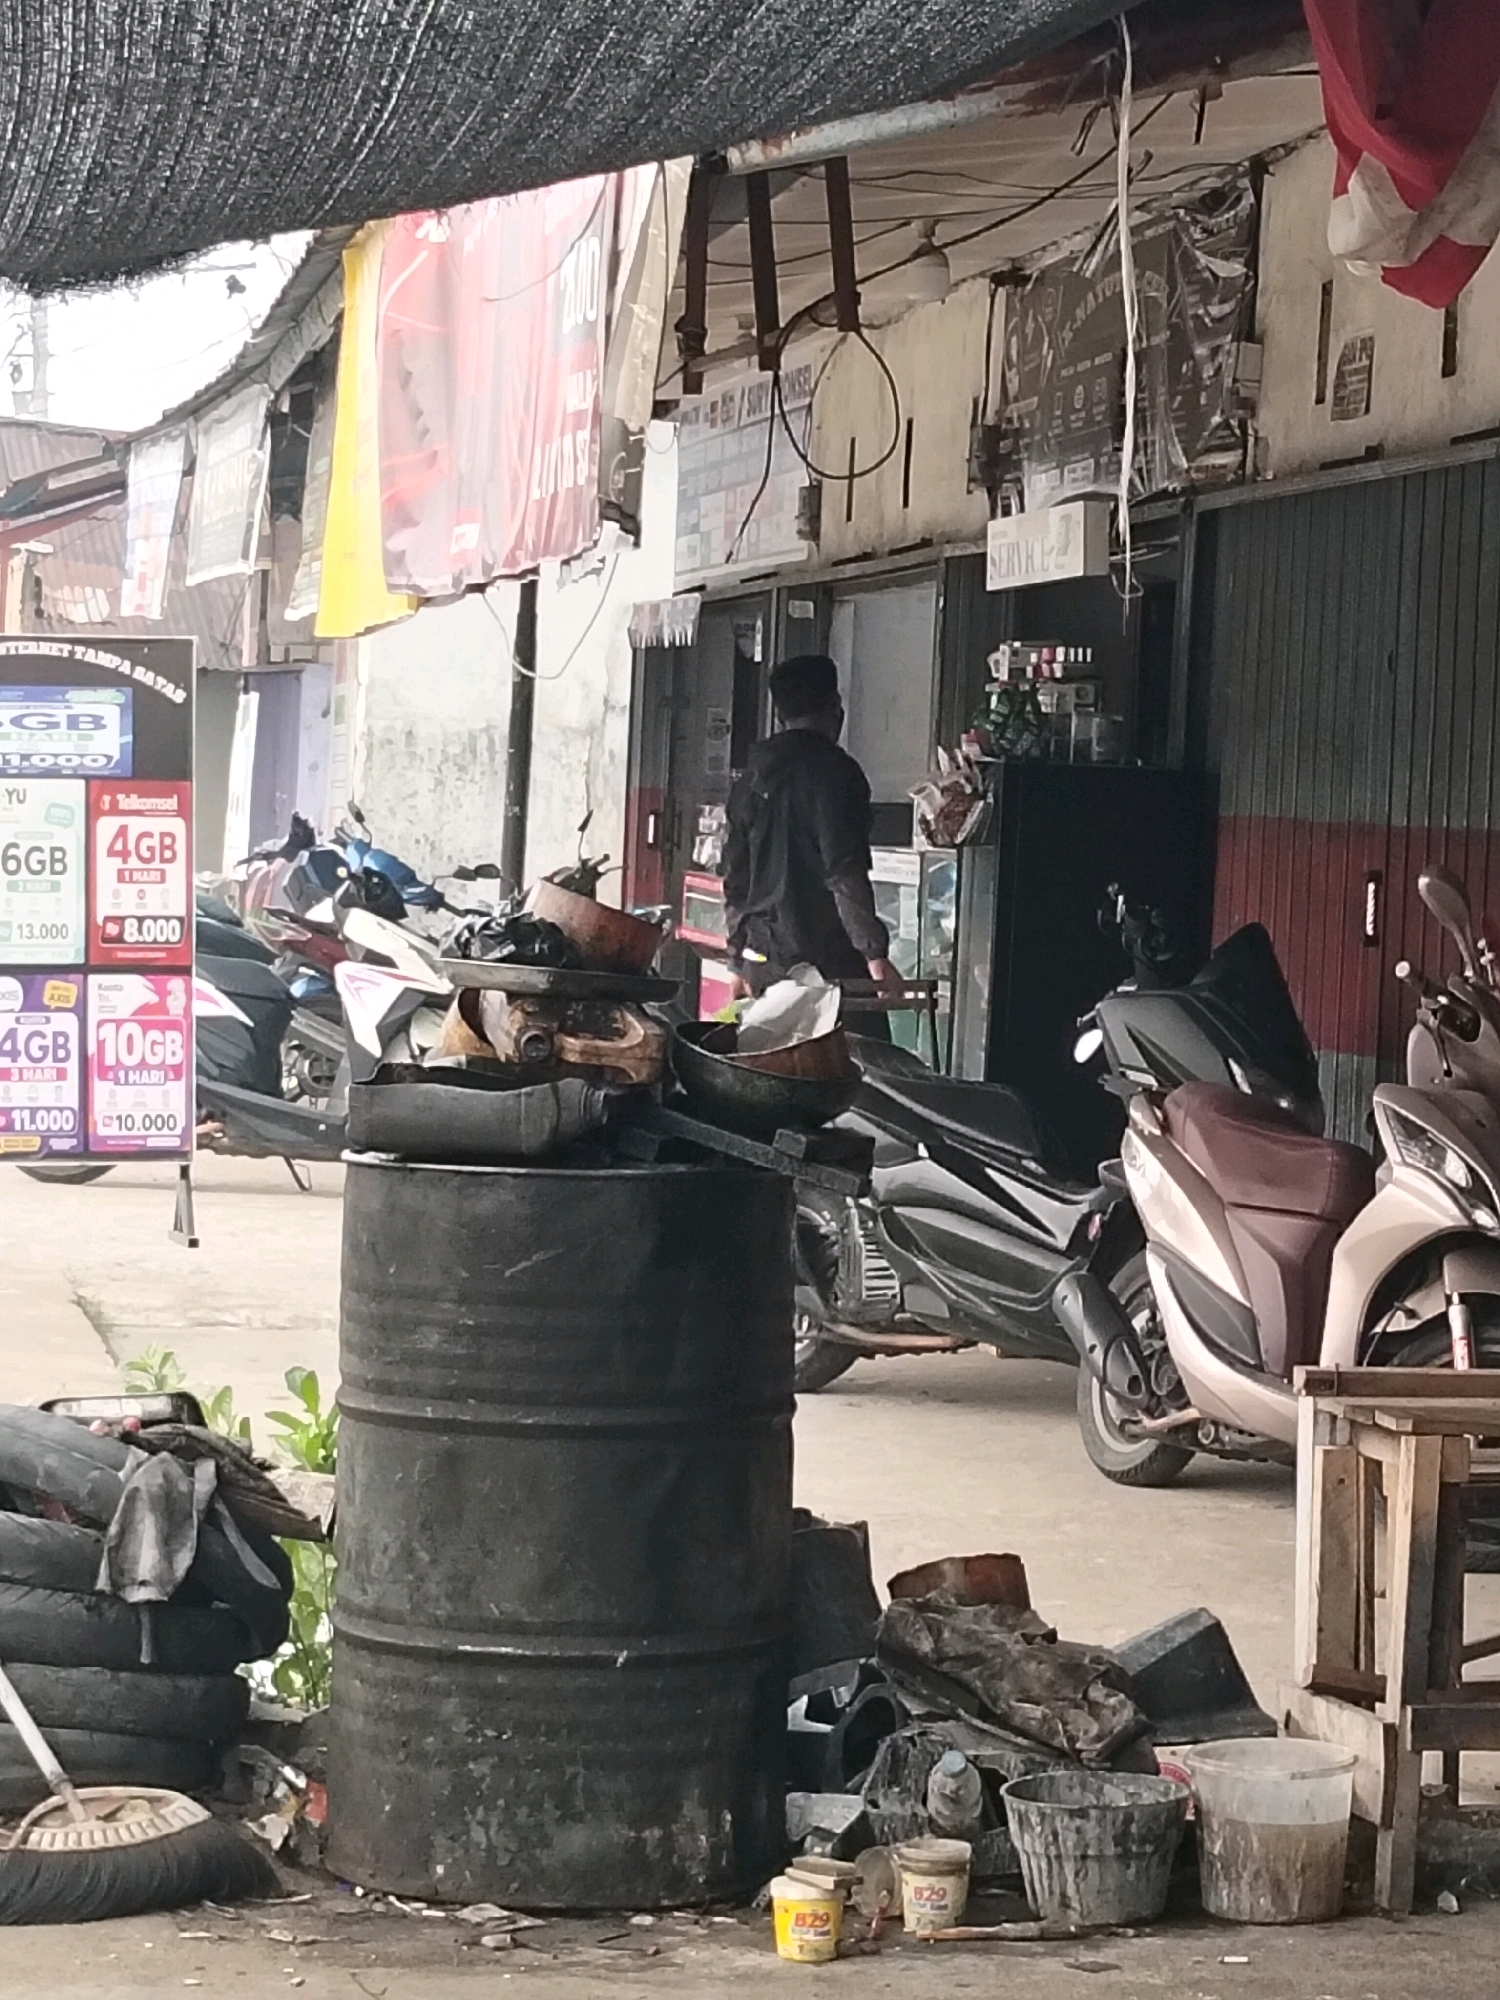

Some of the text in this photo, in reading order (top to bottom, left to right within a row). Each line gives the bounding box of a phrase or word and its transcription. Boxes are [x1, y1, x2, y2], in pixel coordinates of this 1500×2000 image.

[0, 712, 107, 731] GB
[0, 753, 108, 768] 1.000
[106, 824, 178, 865] 4GB
[1, 842, 68, 876] 6GB
[16, 922, 69, 940] 13.000
[123, 917, 181, 943] 8.000
[0, 1027, 72, 1064] 4GB
[98, 1021, 184, 1067] 10GB
[11, 1067, 57, 1081] 3 HARI
[118, 1069, 165, 1085] 1 HARI
[11, 1109, 75, 1131] 11.000
[115, 1113, 178, 1132] 10.000
[914, 1886, 947, 1902] B29
[794, 1911, 831, 1929] B29
